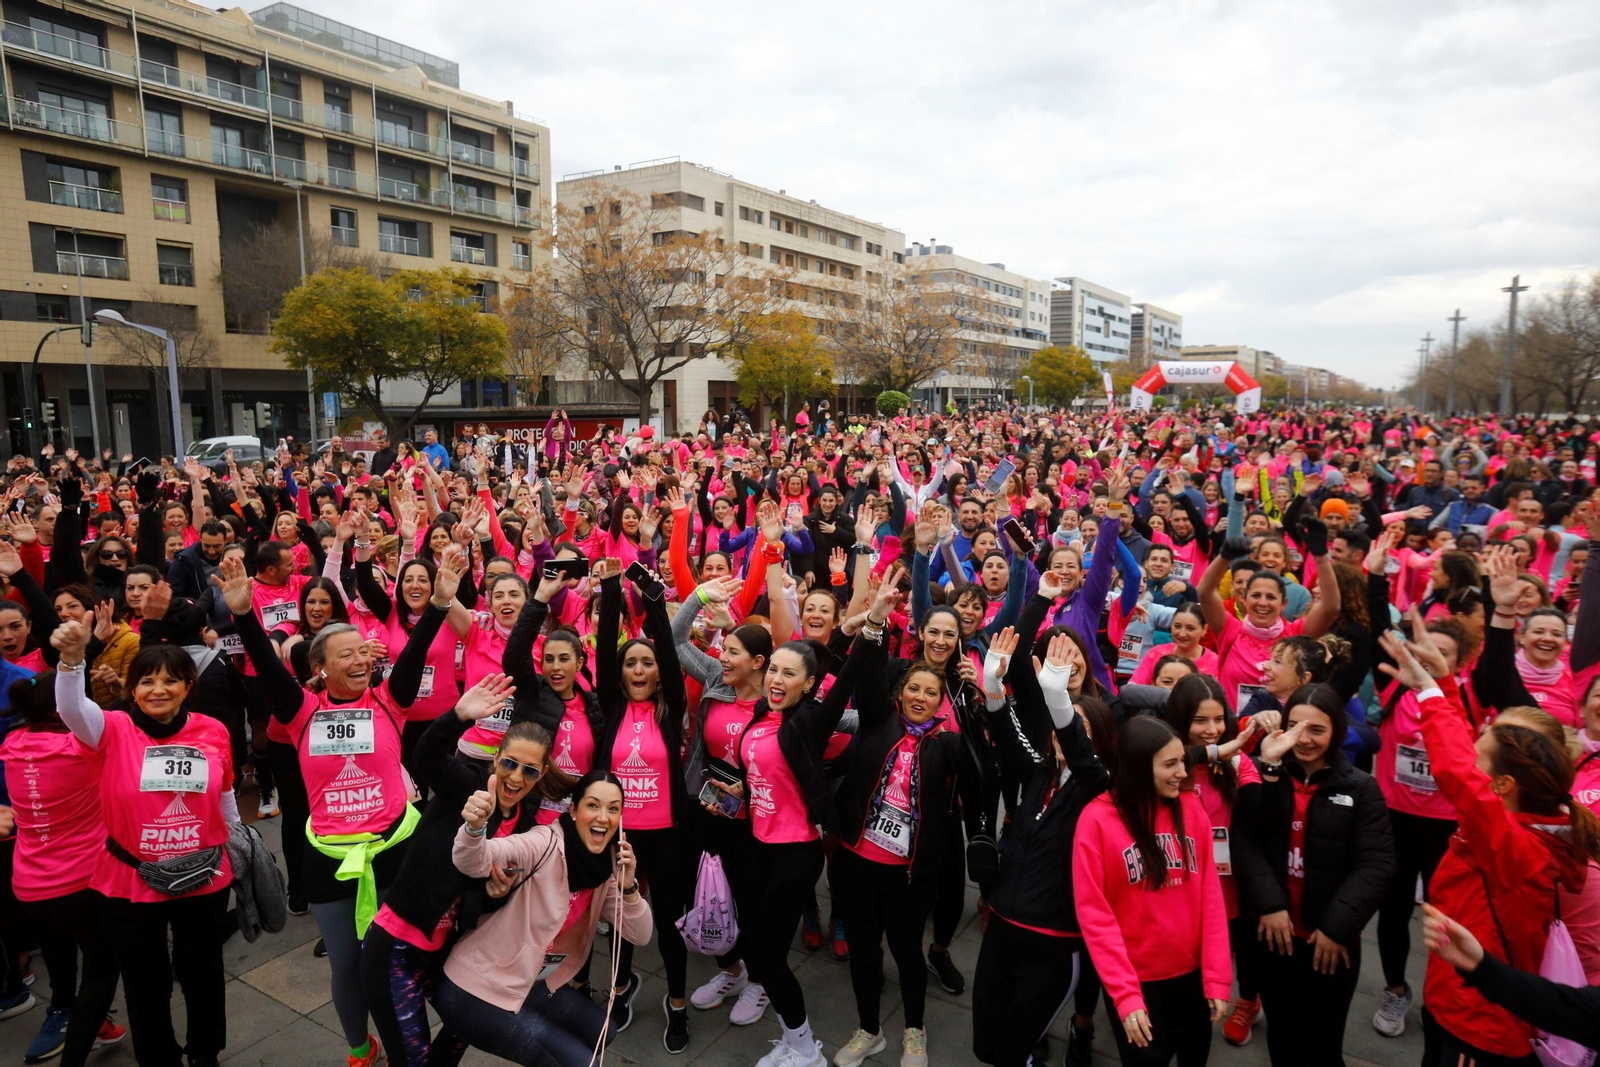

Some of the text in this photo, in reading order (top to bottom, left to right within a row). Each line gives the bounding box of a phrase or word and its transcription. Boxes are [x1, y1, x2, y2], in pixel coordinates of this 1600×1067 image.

[1168, 366, 1211, 377] cajasur
[275, 611, 289, 621] 712
[222, 637, 242, 647] 1425
[327, 724, 355, 739] 396
[165, 760, 192, 775] 313
[324, 784, 383, 804] PINK
[624, 790, 659, 798] NNING
[327, 798, 384, 813] RUNNING
[345, 813, 369, 823] 2023
[141, 824, 201, 842] PINK
[140, 839, 200, 851] RUNNING
